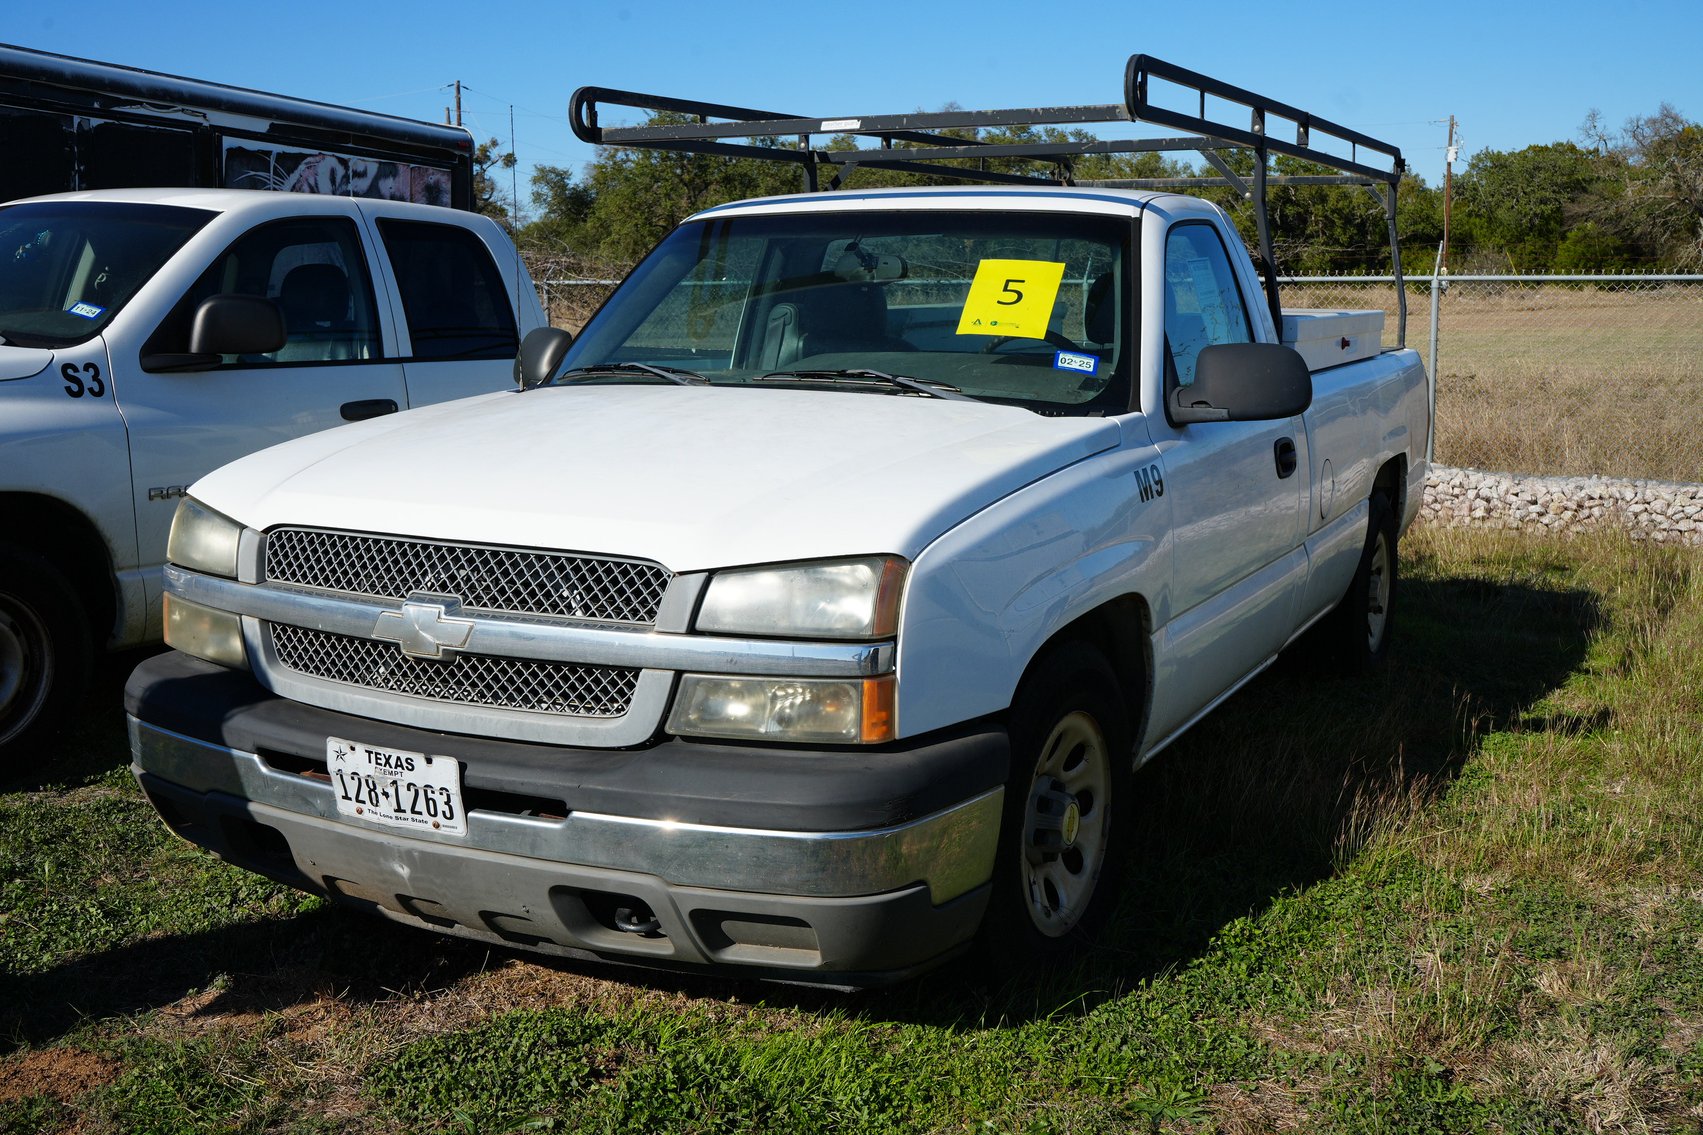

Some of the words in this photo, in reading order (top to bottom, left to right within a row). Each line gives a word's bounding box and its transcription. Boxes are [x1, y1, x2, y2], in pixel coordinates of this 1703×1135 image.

[996, 279, 1026, 306] 5
[61, 362, 105, 398] S3
[1133, 464, 1164, 503] M9
[364, 749, 415, 772] TEXAS
[368, 808, 379, 816] The
[379, 812, 394, 820] Lone
[410, 817, 429, 825] State
